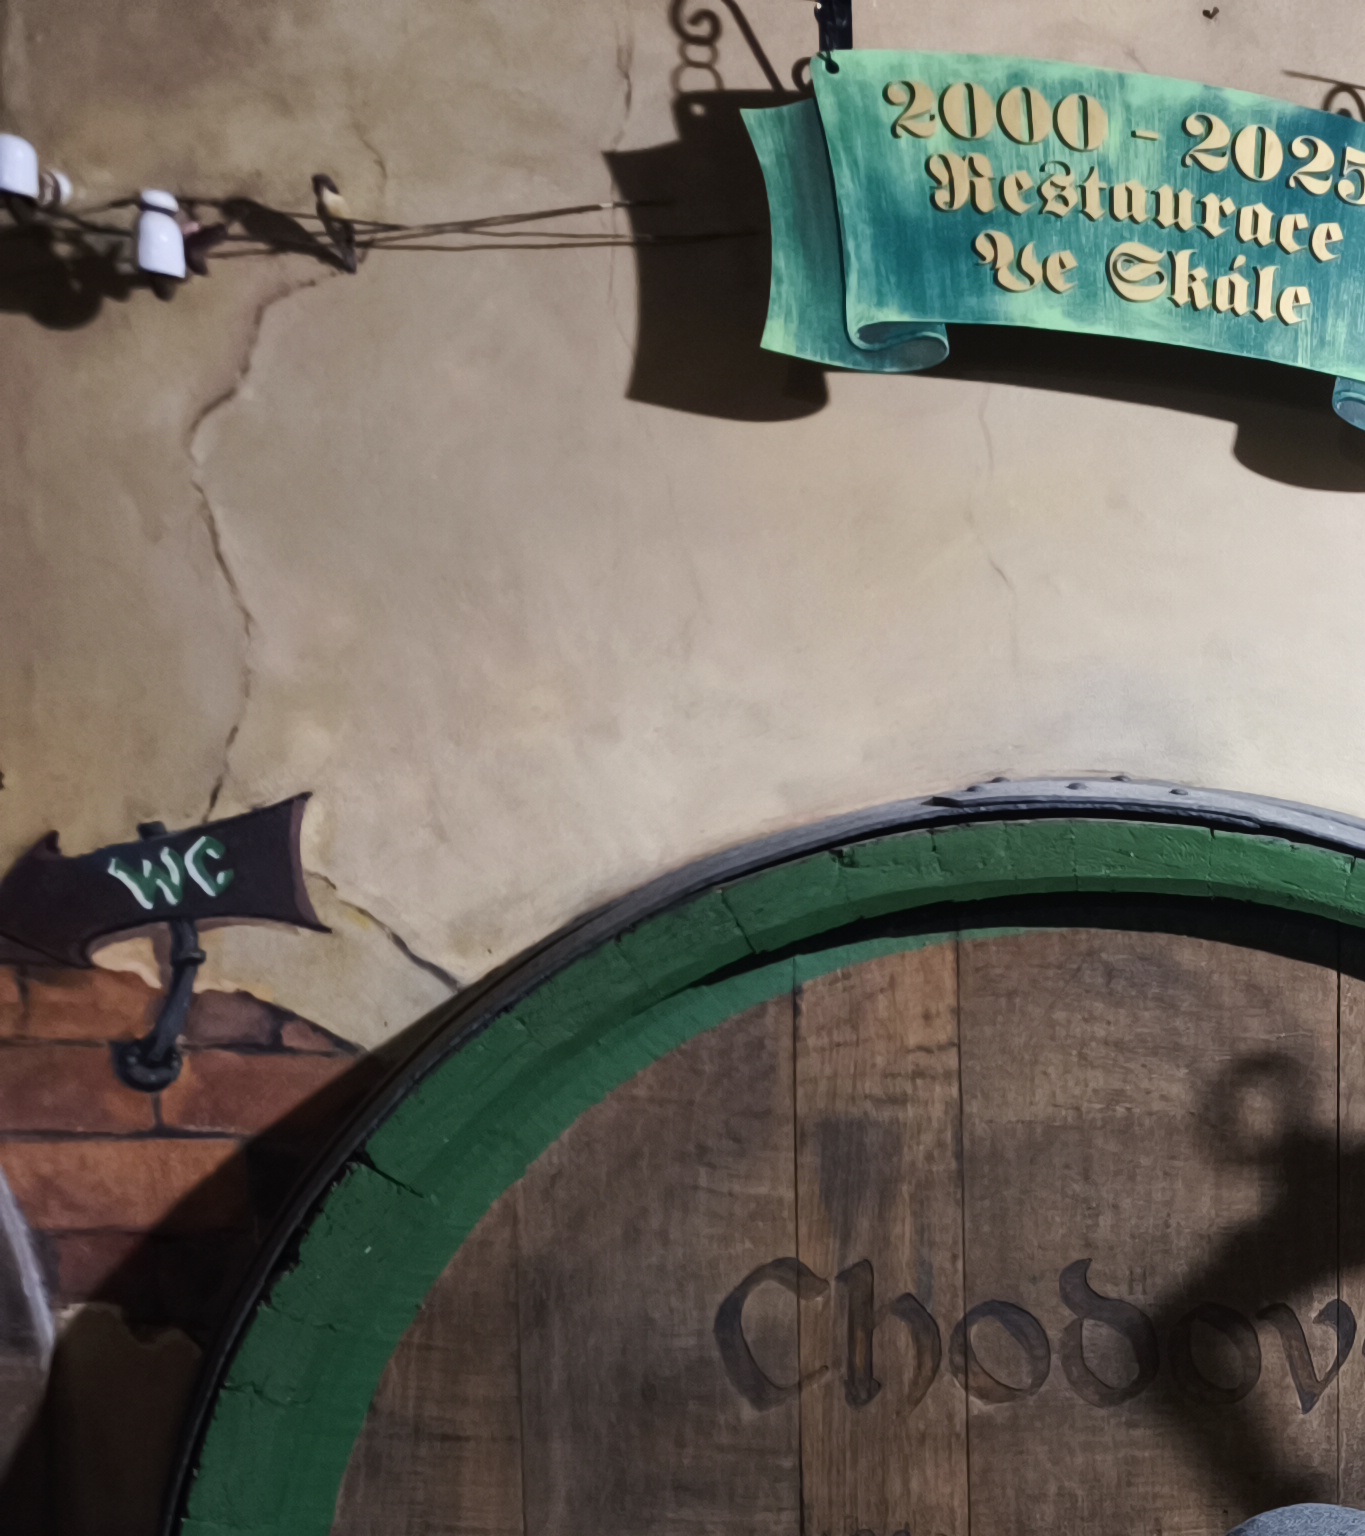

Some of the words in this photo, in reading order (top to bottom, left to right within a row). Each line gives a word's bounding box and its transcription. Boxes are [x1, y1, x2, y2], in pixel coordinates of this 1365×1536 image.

[882, 80, 1108, 152] 2000
[924, 152, 1344, 263] Restaurace
[971, 230, 1078, 294] Ve
[1105, 242, 1311, 326] Skále
[107, 836, 234, 909] WC
